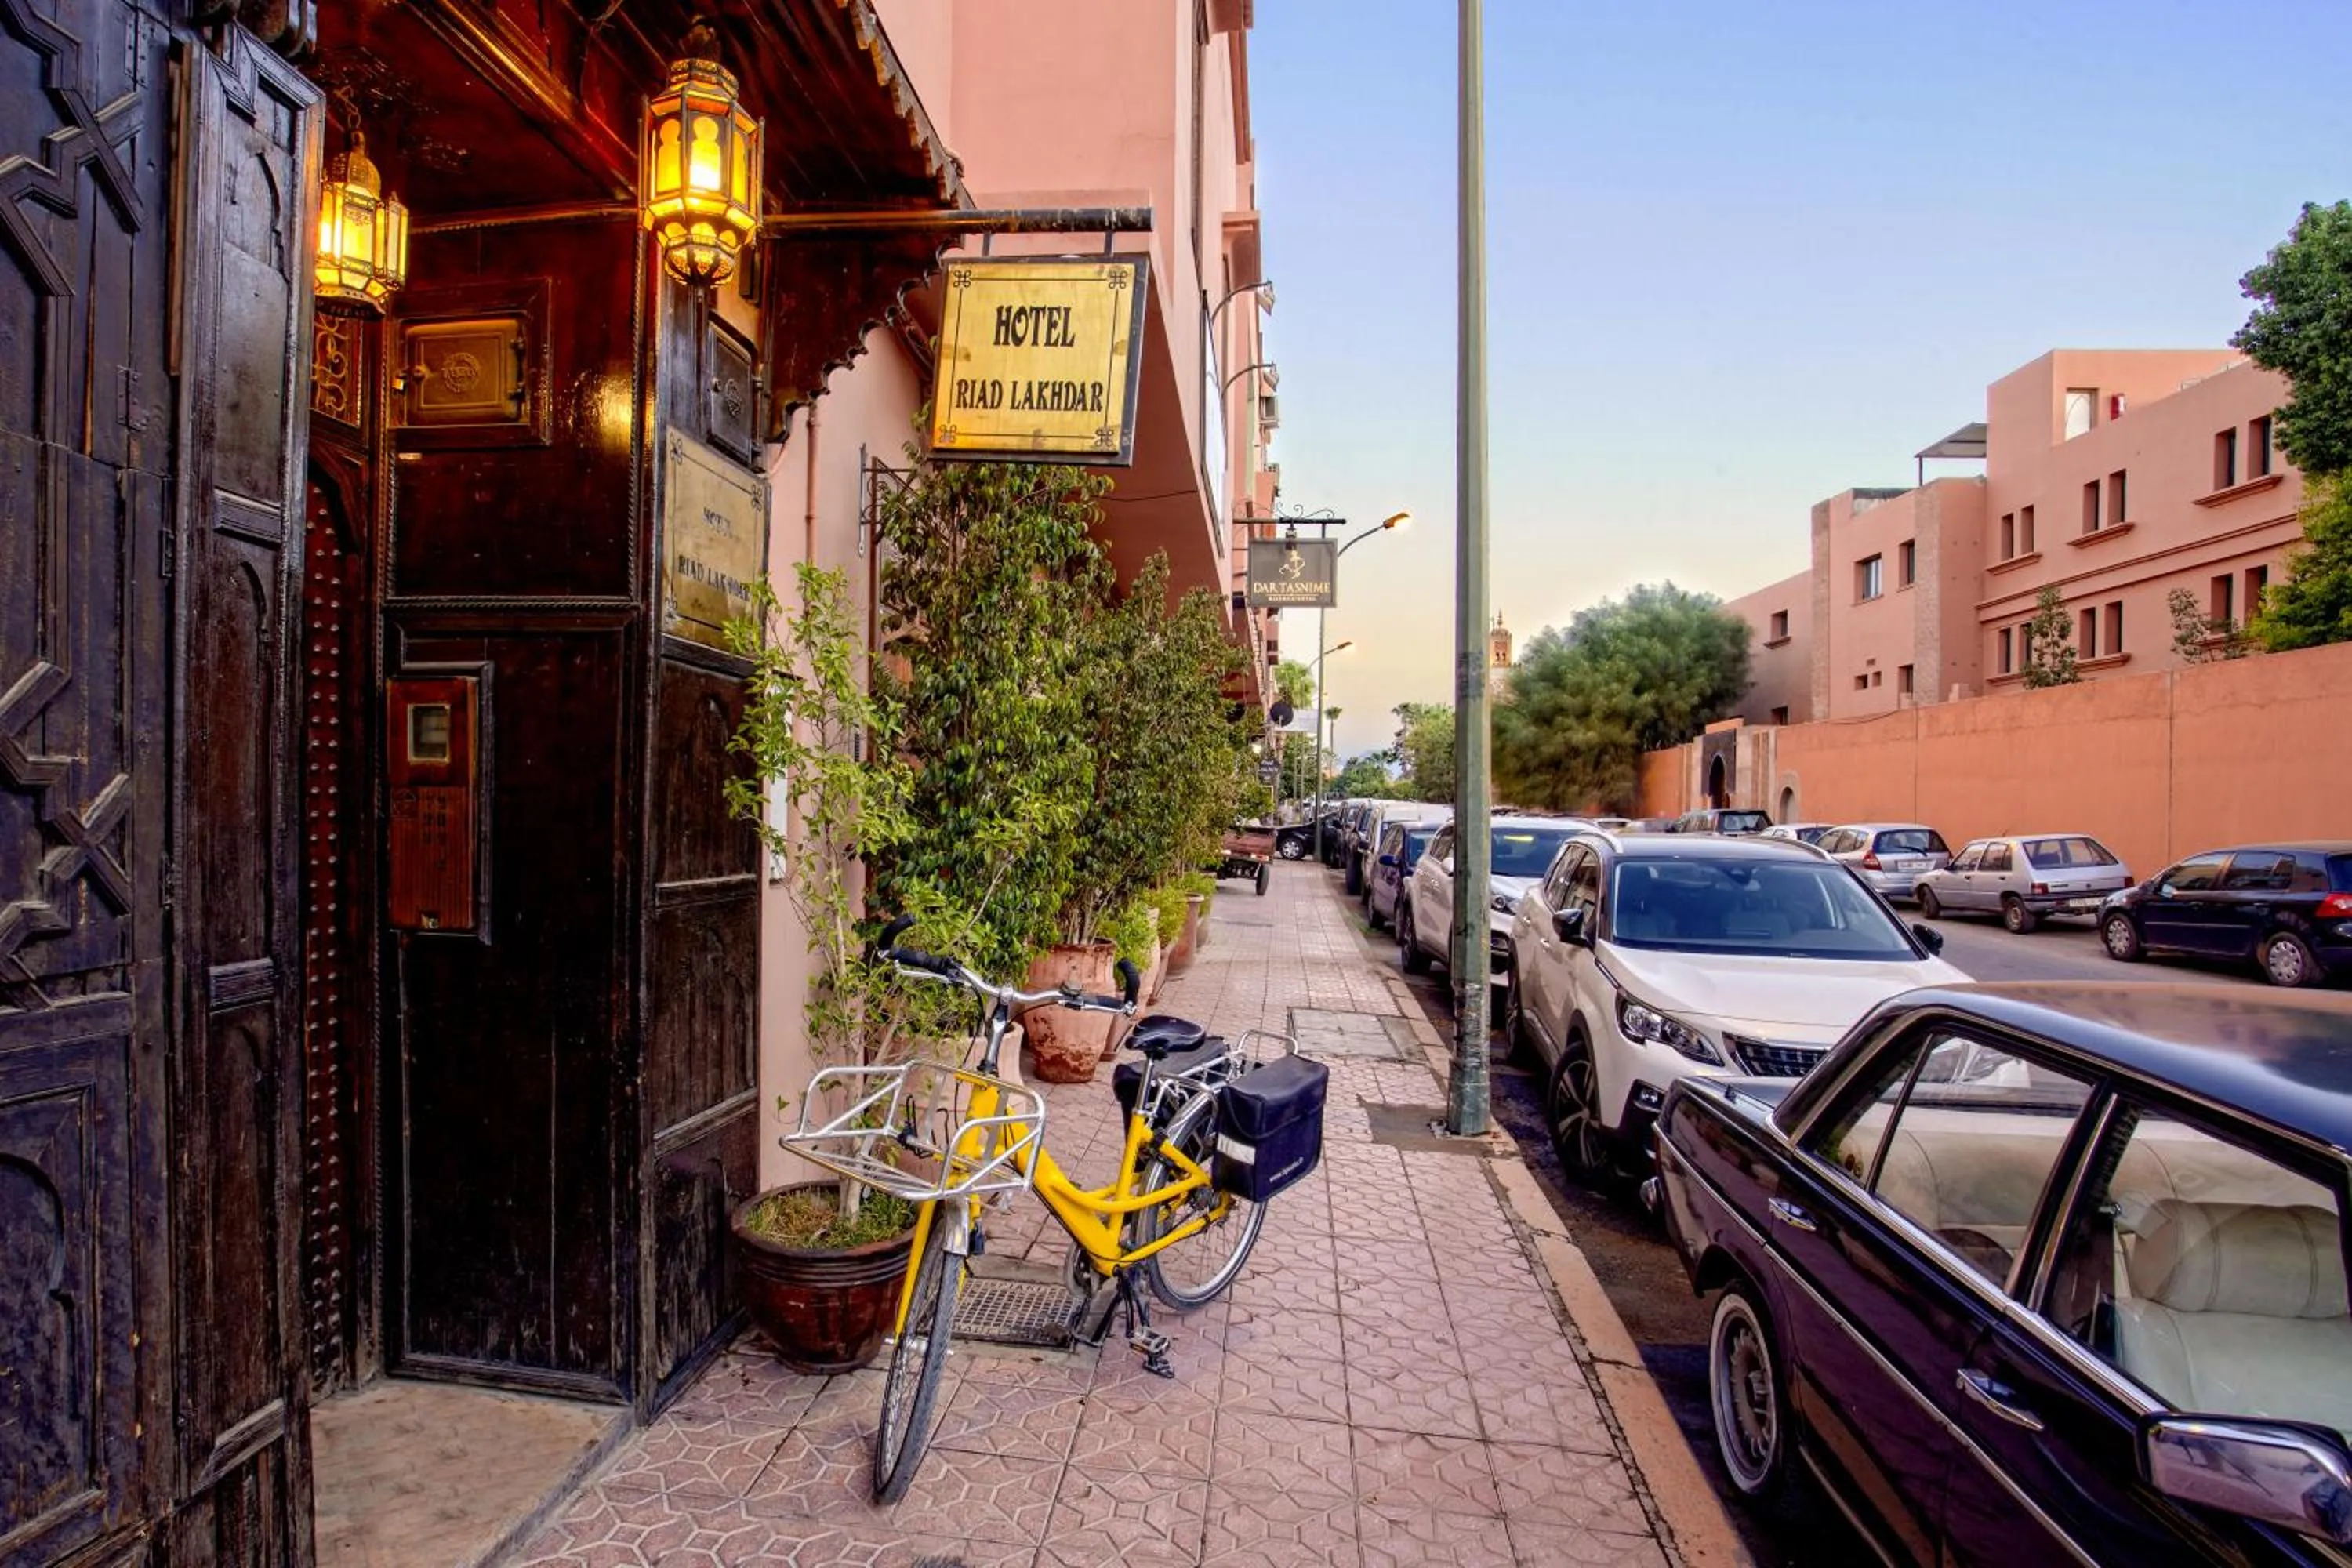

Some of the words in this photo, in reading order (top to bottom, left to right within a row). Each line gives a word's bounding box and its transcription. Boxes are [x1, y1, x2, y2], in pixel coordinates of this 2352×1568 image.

[993, 305, 1075, 347] HOTEL
[956, 379, 1003, 409] RIAD
[1010, 380, 1104, 412] LAKHDAR
[678, 554, 704, 582] RIAD
[1254, 582, 1278, 593] DAR
